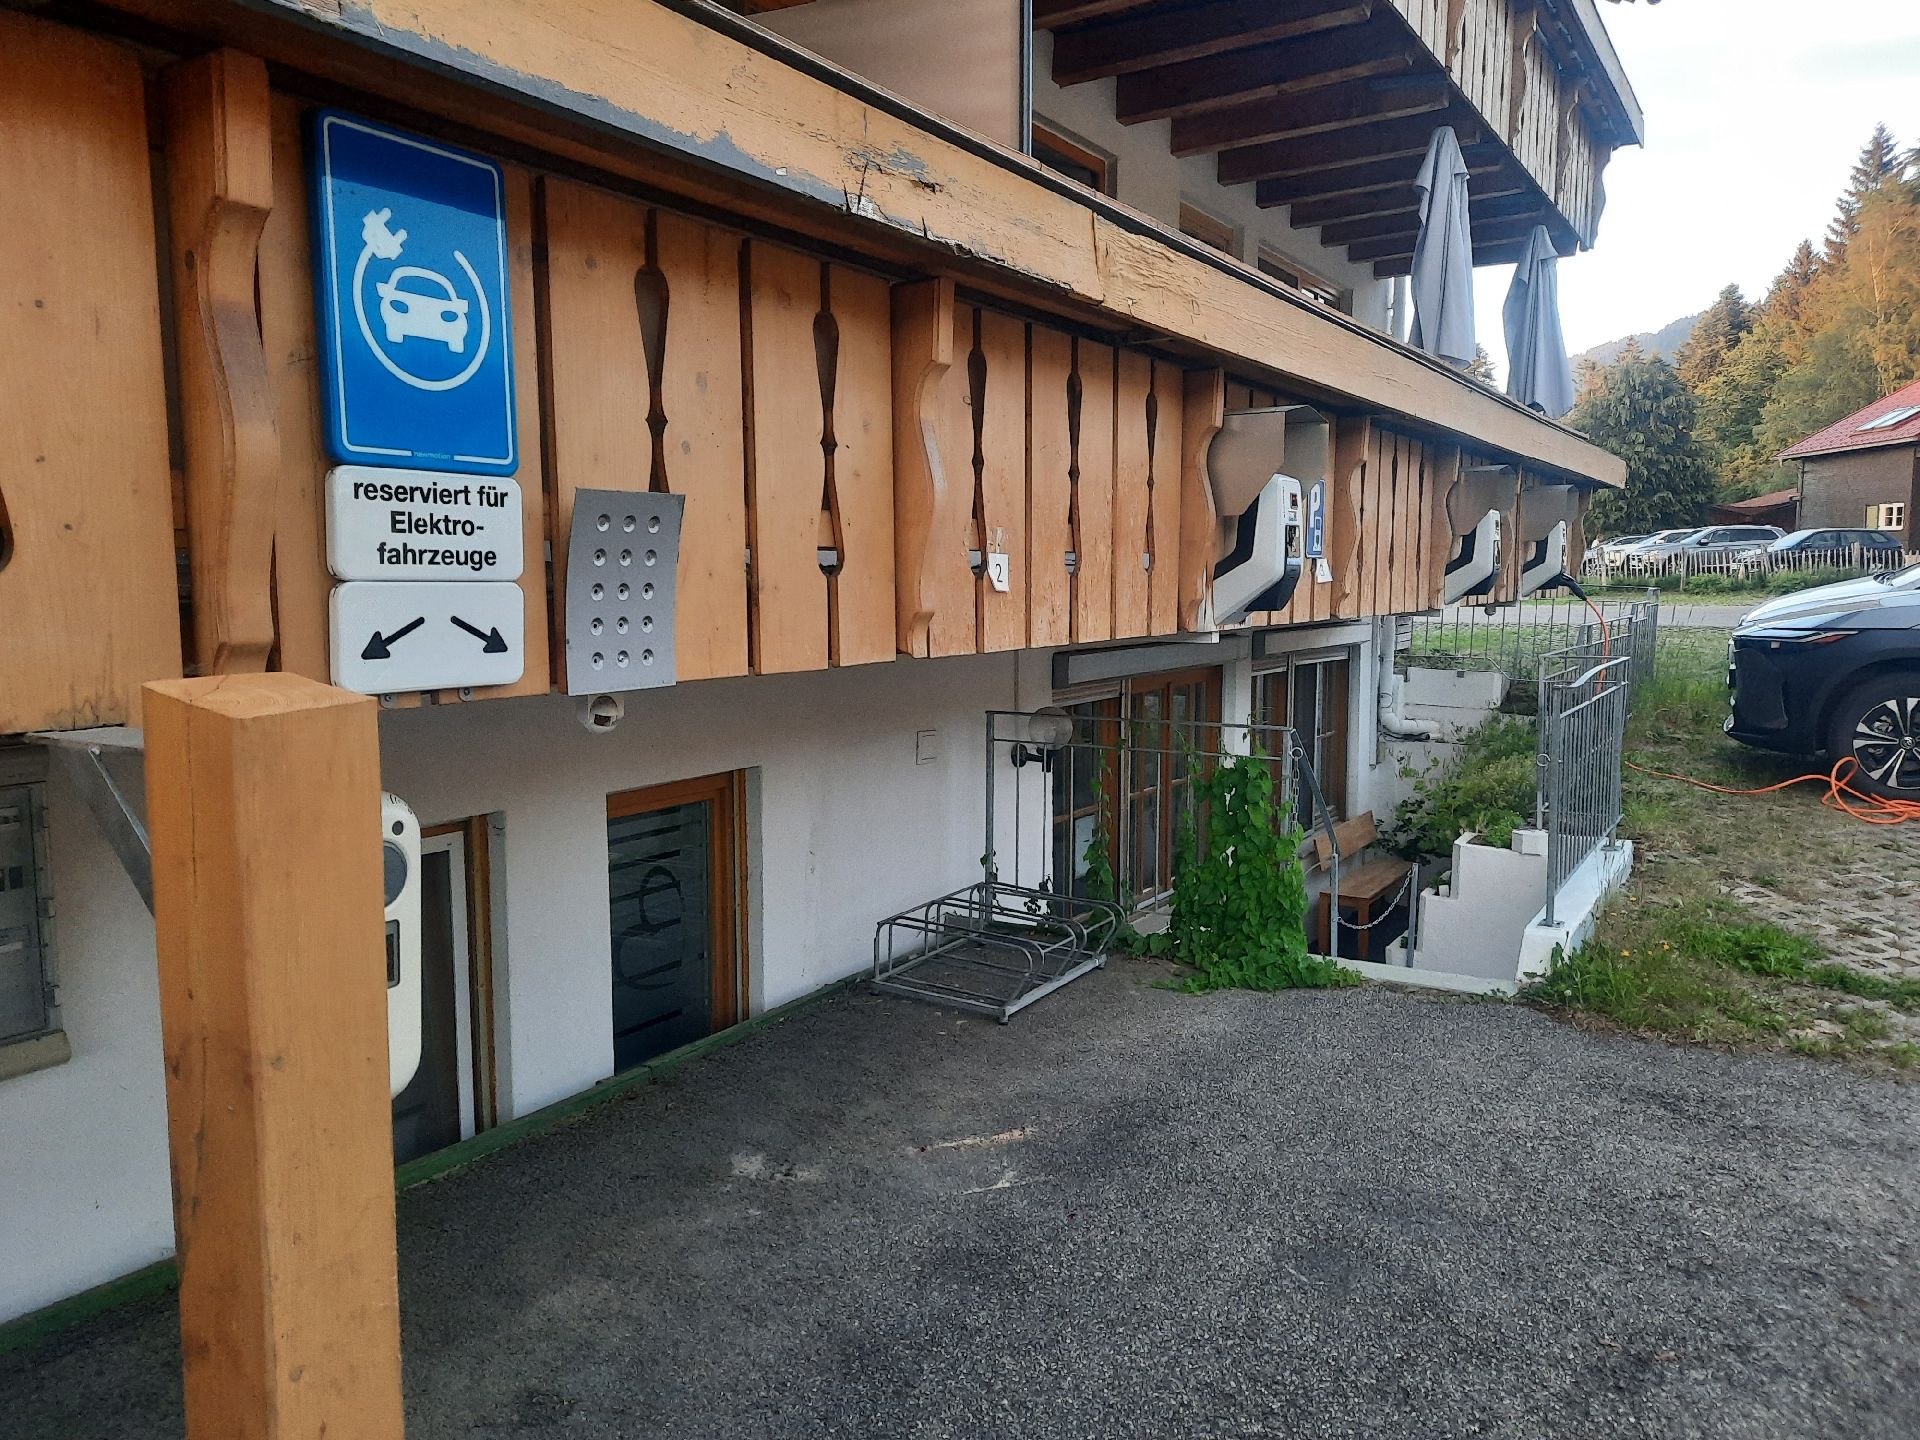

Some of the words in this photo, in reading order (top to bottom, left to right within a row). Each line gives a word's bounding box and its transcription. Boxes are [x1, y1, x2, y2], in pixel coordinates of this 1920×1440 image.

[353, 481, 471, 506] reserviert
[477, 485, 509, 508] für
[390, 510, 485, 536] Elektro-
[376, 541, 497, 571] fahrzeuge
[995, 563, 1003, 583] 2
